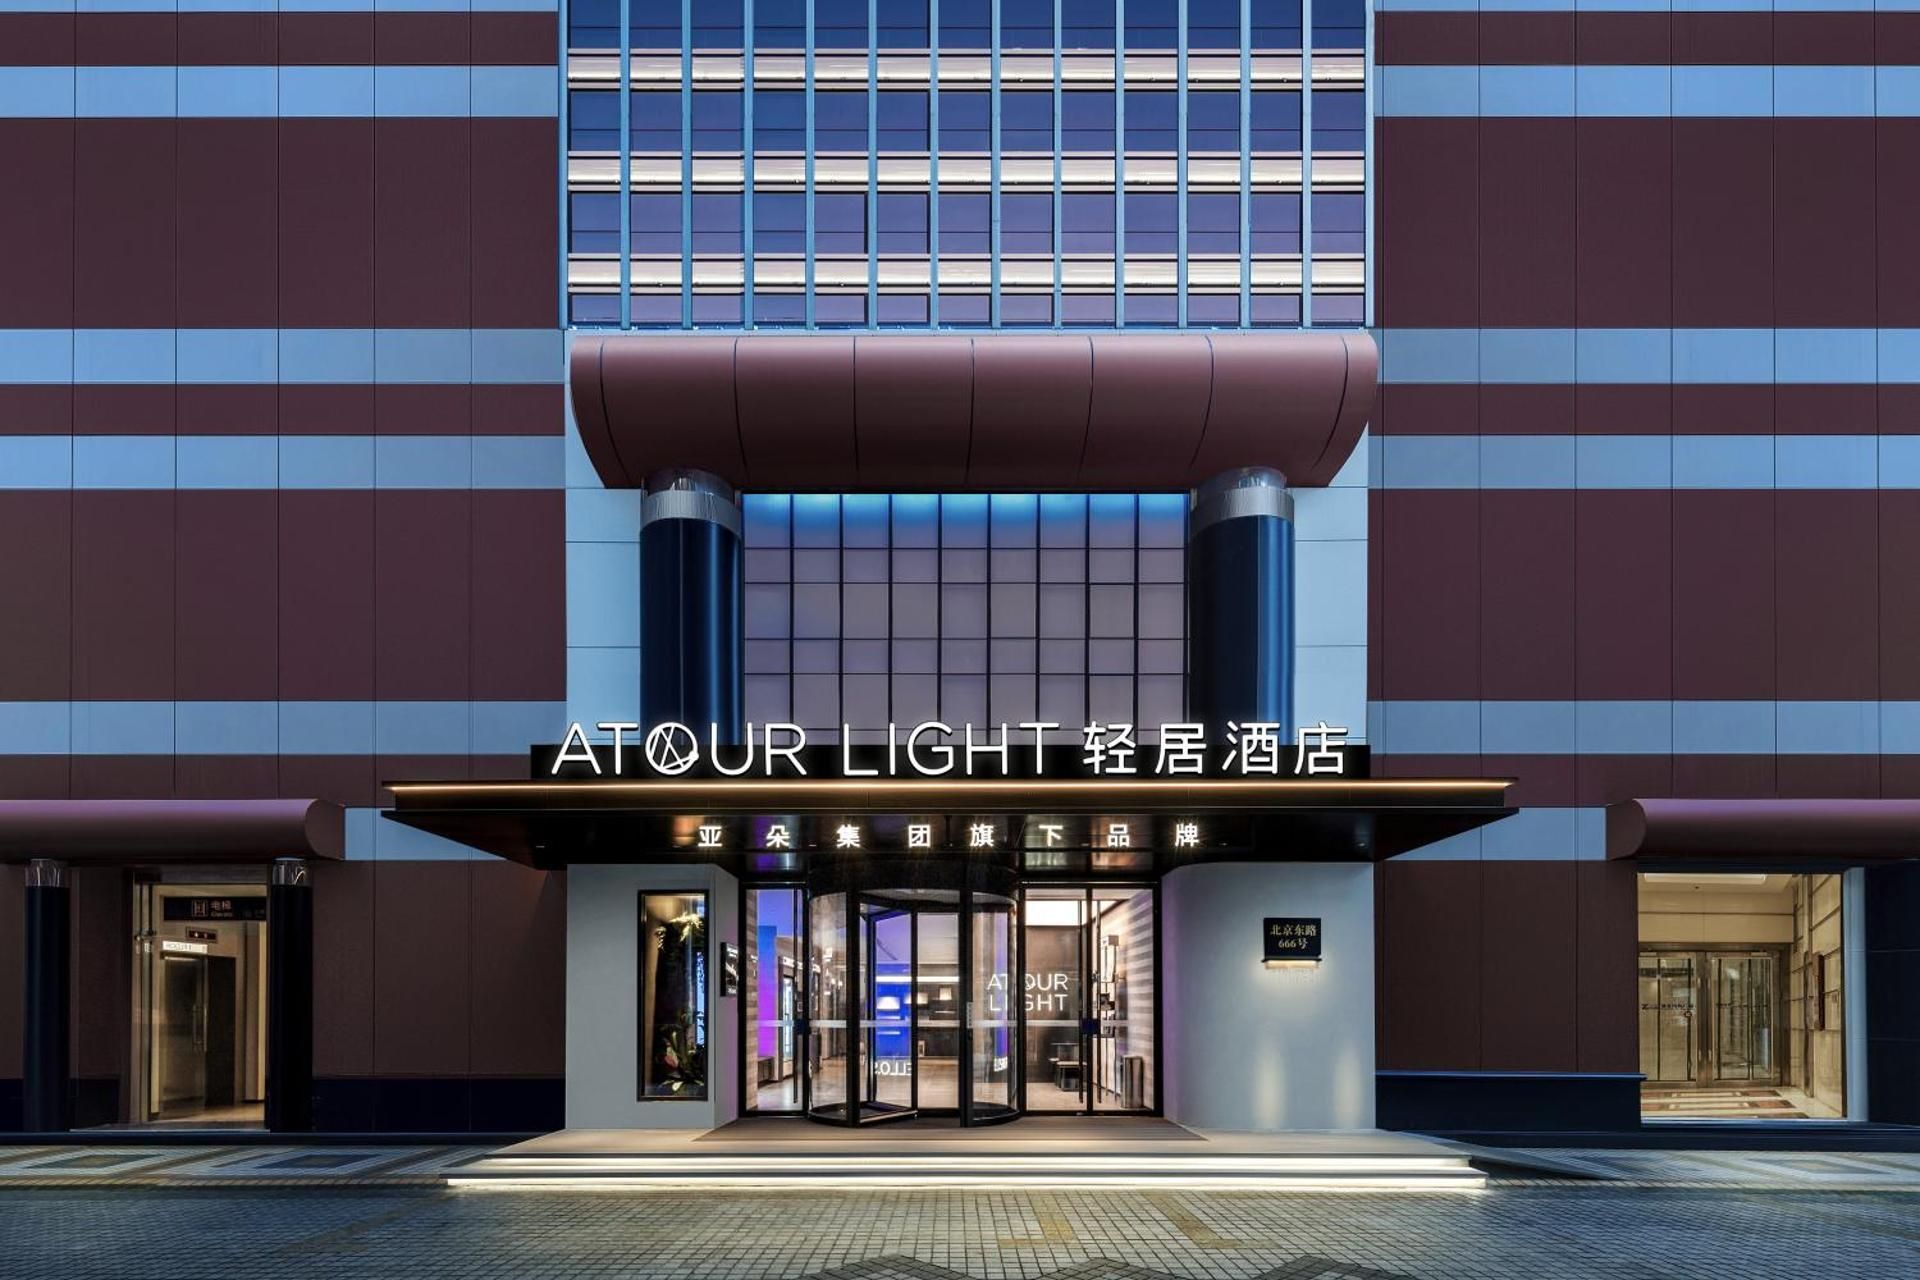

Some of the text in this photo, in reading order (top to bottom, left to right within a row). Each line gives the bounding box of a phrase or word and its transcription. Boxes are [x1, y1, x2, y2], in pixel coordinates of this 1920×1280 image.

[551, 720, 1349, 776] ATOUR LIGHT 轻居酒店
[698, 823, 1200, 848] 亚朵集团旗下品牌
[1270, 924, 1317, 936] 北京东路
[1278, 937, 1308, 949] 666号
